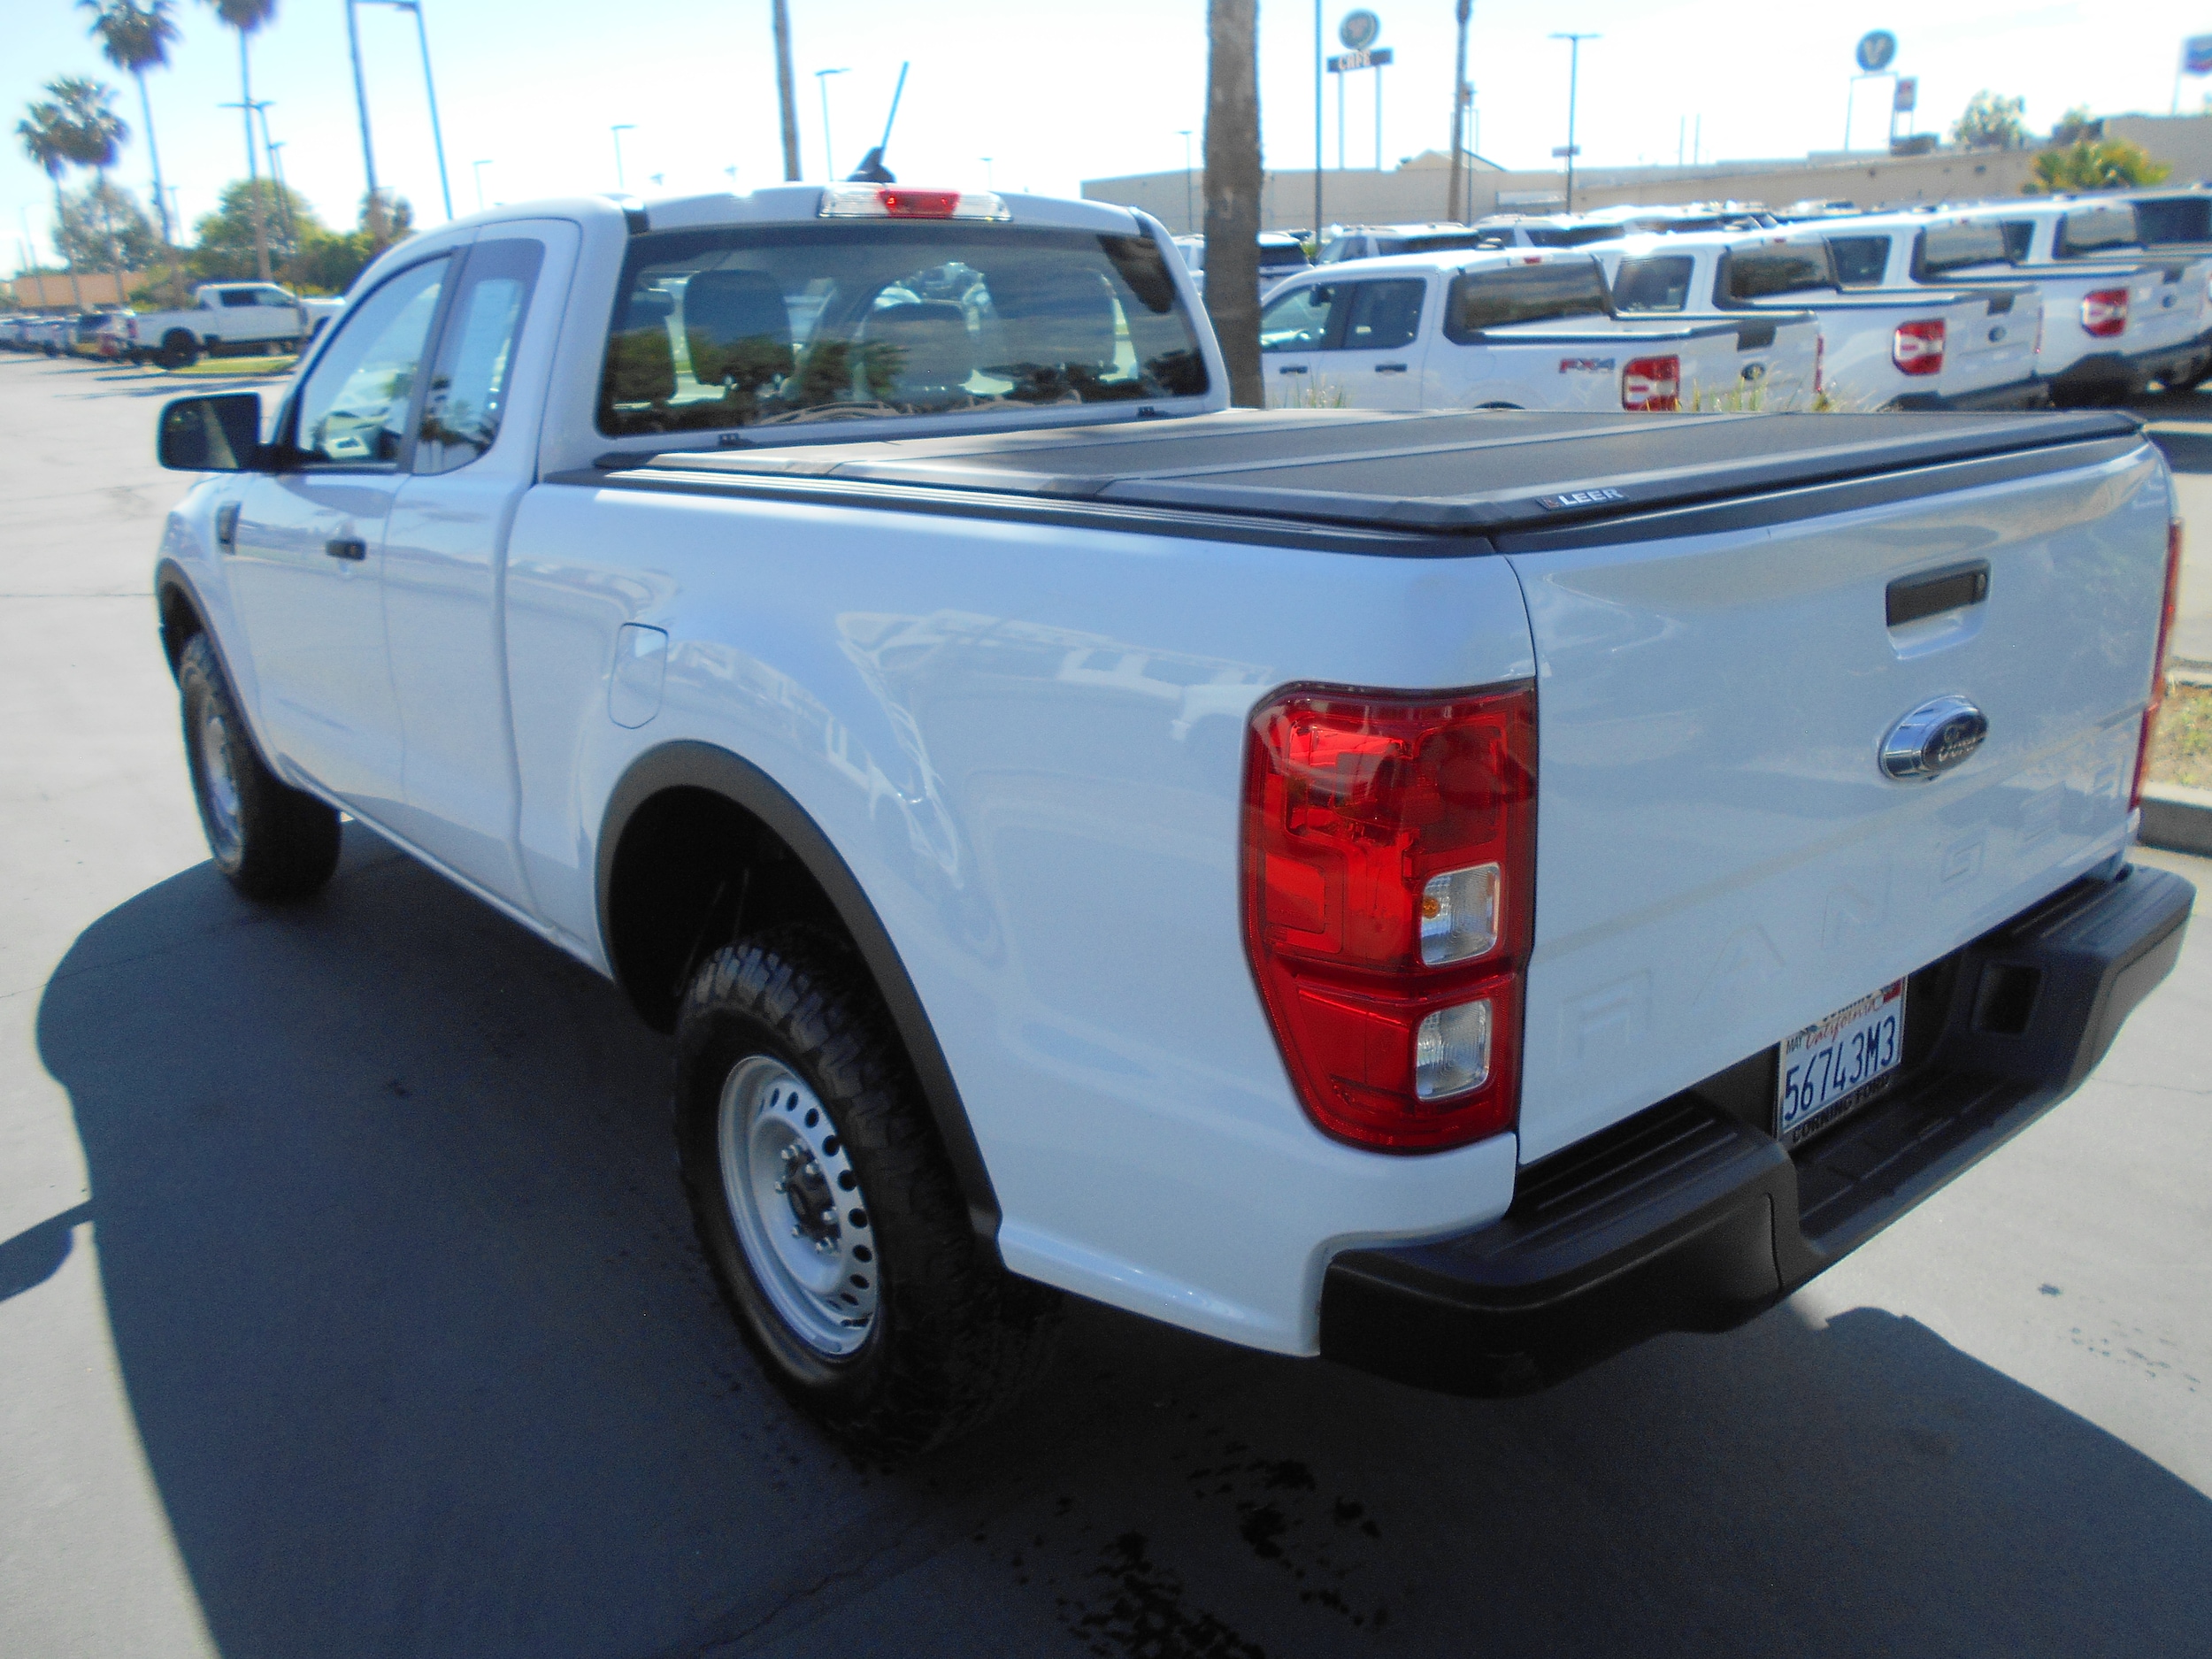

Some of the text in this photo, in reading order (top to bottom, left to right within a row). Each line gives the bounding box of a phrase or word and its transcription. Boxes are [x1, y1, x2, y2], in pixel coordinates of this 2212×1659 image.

[1559, 357, 1616, 373] FX4
[1558, 488, 1624, 506] LEER
[1784, 1015, 1896, 1122] 56743M3
